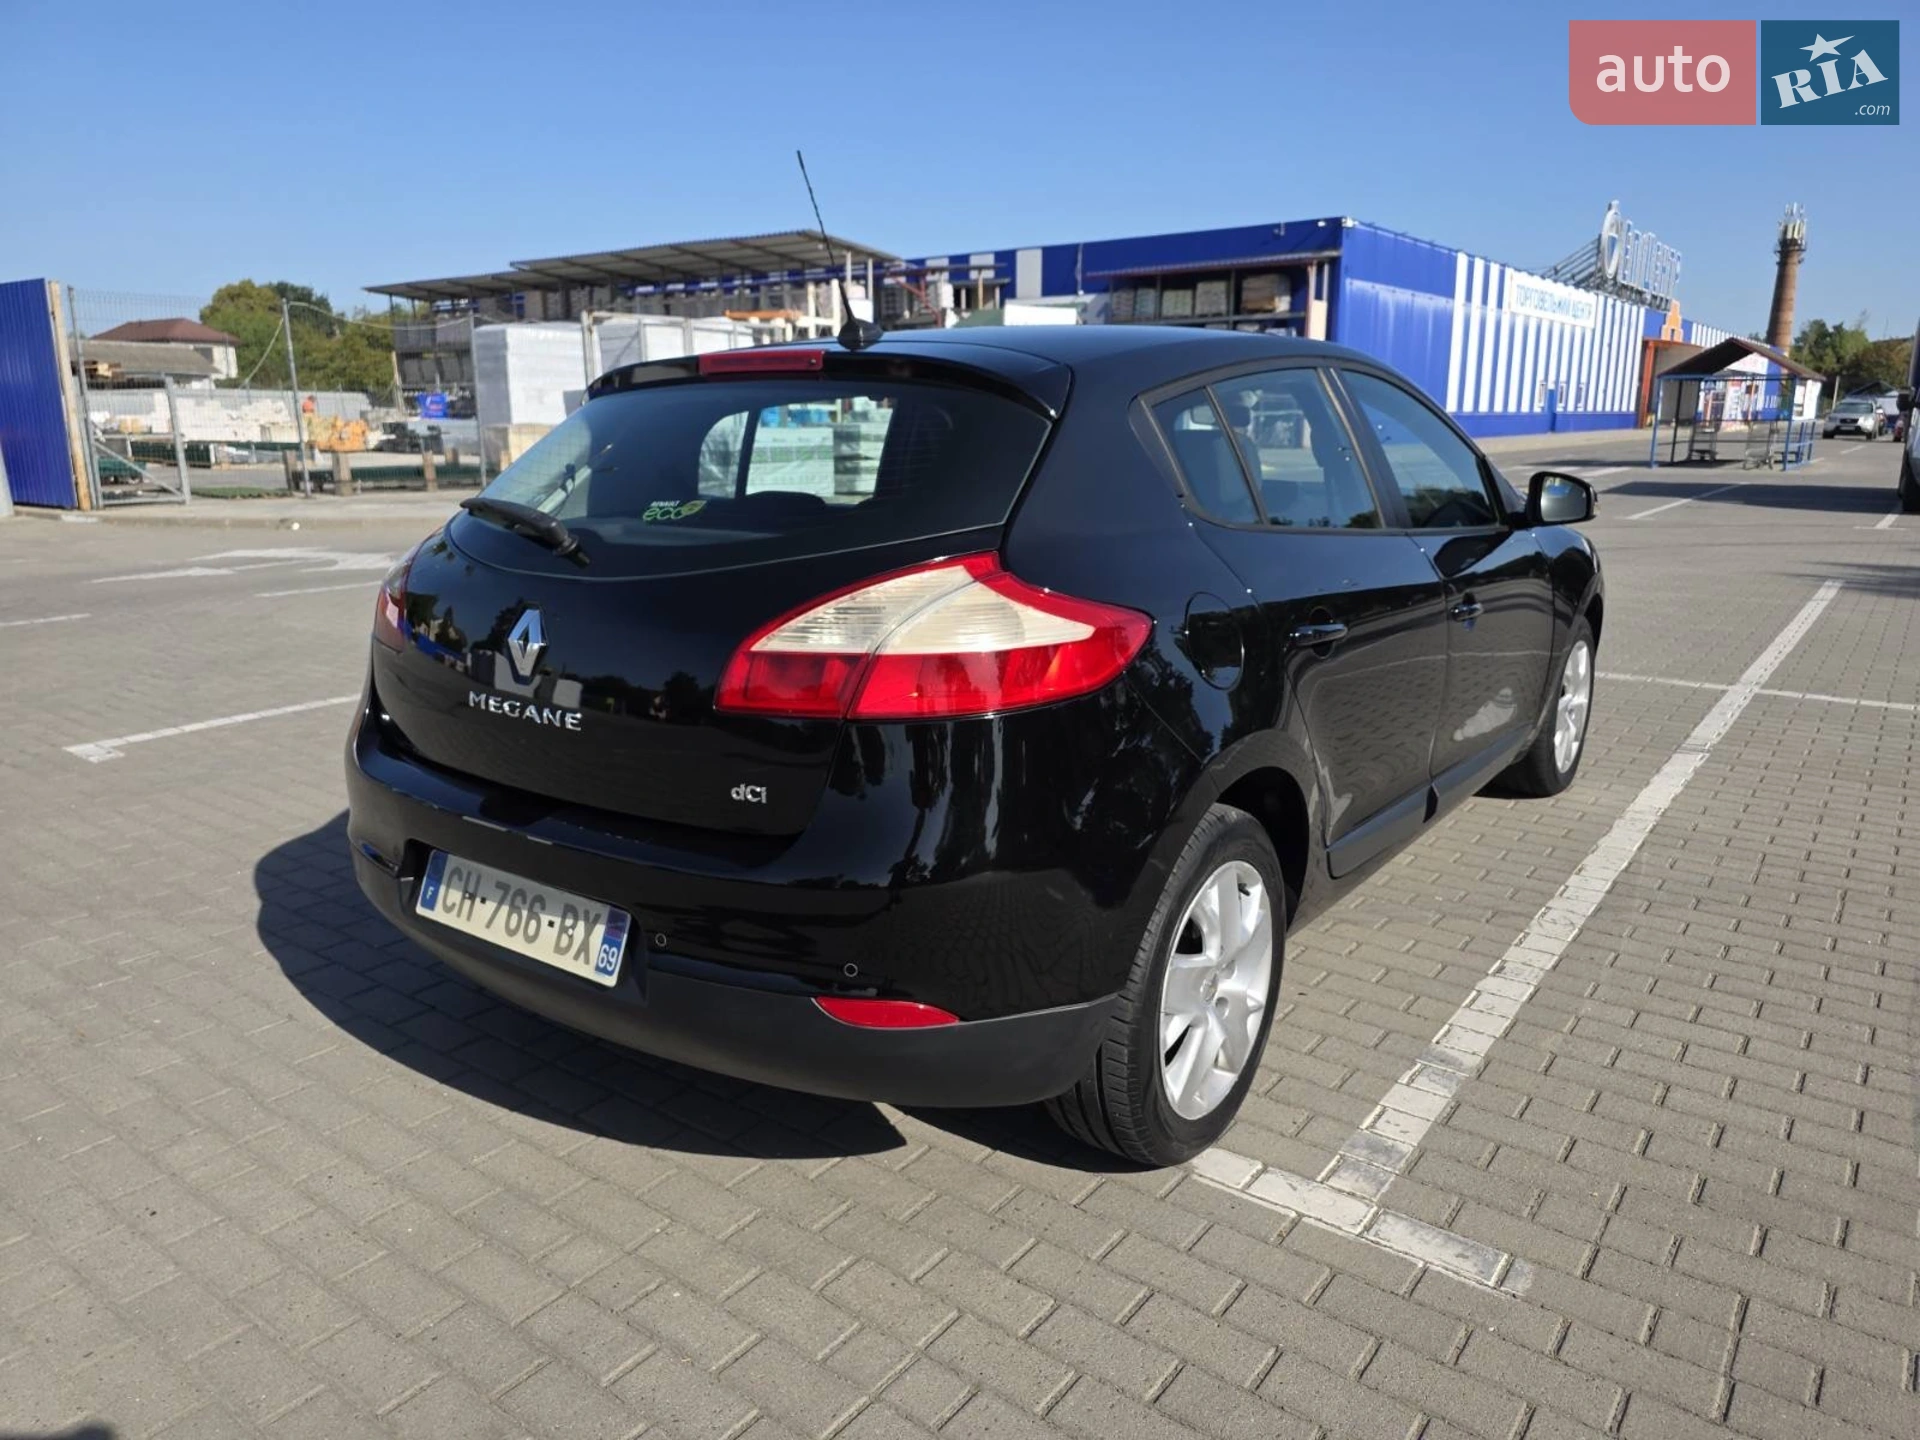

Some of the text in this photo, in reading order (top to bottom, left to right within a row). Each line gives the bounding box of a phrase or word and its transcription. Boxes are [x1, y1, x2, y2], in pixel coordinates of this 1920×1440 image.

[468, 690, 582, 732] MEGANE
[426, 886, 435, 899] F
[441, 866, 602, 966] CH-766-BX
[598, 943, 618, 972] 69
